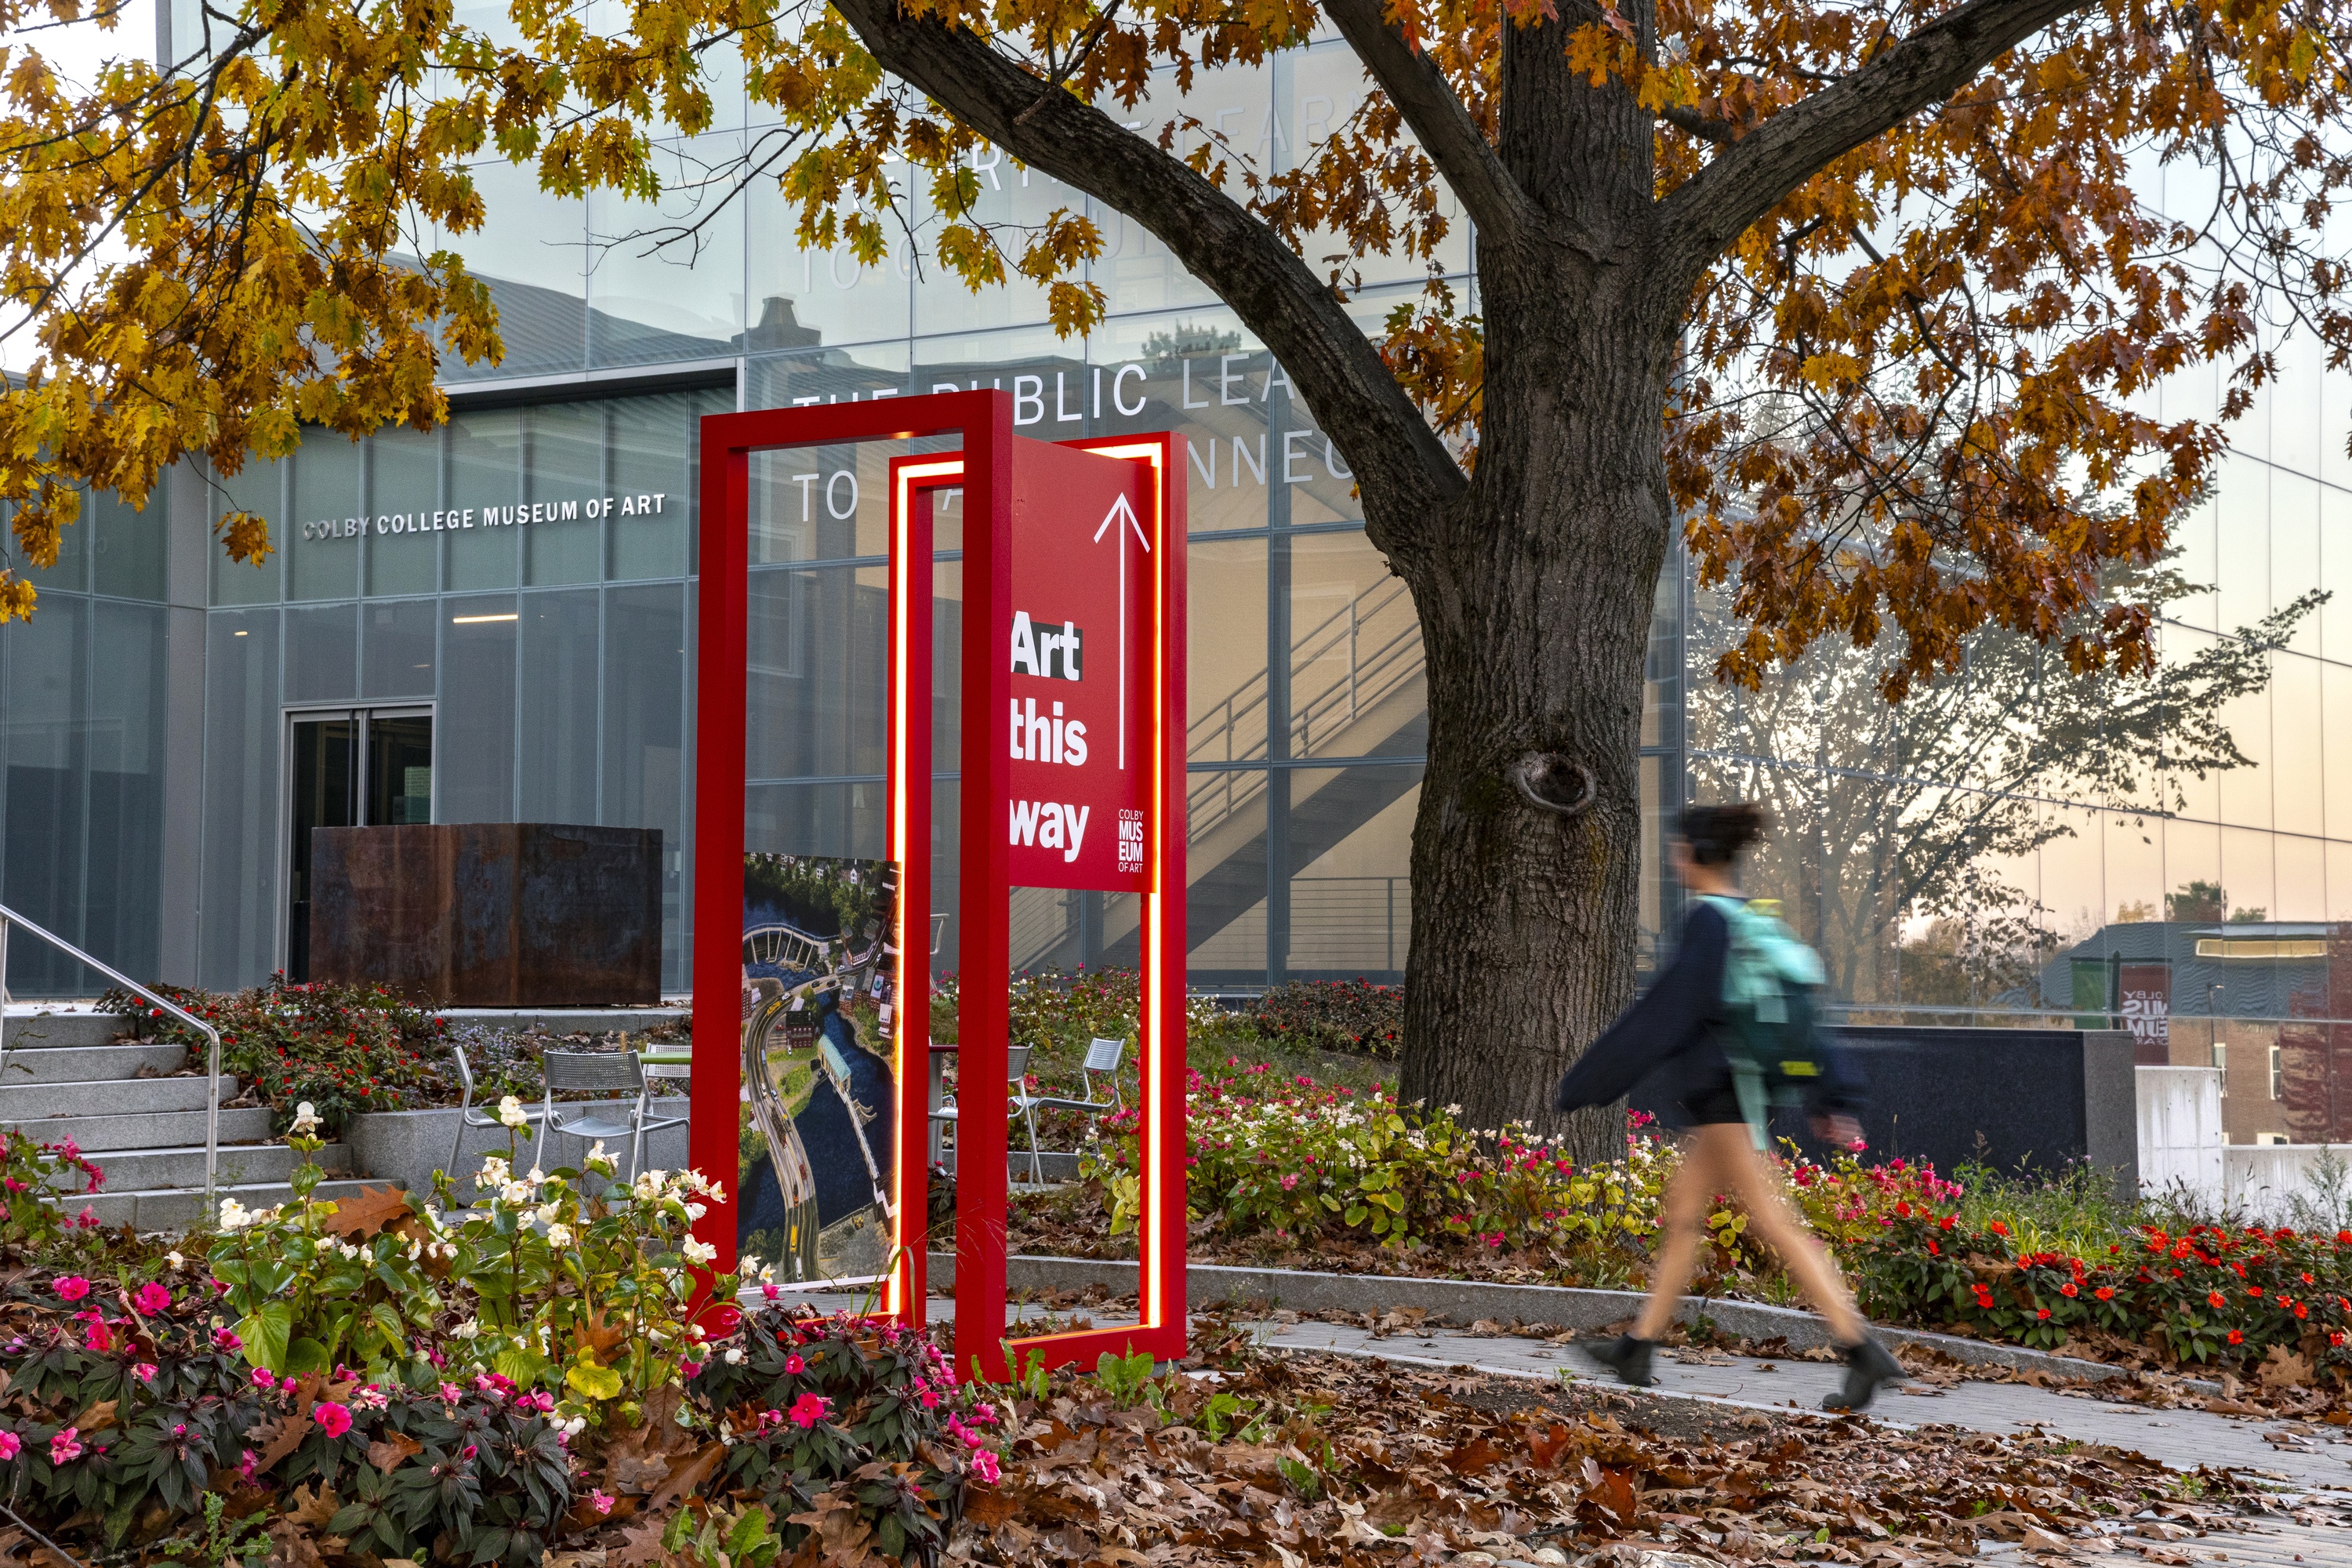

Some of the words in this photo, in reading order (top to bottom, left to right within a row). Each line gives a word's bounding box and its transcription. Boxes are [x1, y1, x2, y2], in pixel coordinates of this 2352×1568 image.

[793, 238, 863, 293] TO
[932, 364, 1147, 426] BLIC
[1183, 354, 1296, 410] LEA
[303, 517, 371, 540] COLBY
[377, 509, 474, 535] COLLEGE
[483, 501, 577, 527] MUSEUM
[586, 497, 614, 519] OF
[621, 493, 666, 516] ART
[793, 470, 858, 522] TO
[1011, 610, 1080, 681] Art
[1010, 697, 1088, 767] this
[1009, 799, 1091, 863] way
[1119, 808, 1144, 821] COLBY
[1119, 820, 1143, 842] MUS
[1118, 862, 1129, 873] OF
[1129, 862, 1143, 873] ART
[1119, 840, 1143, 862] EUM
